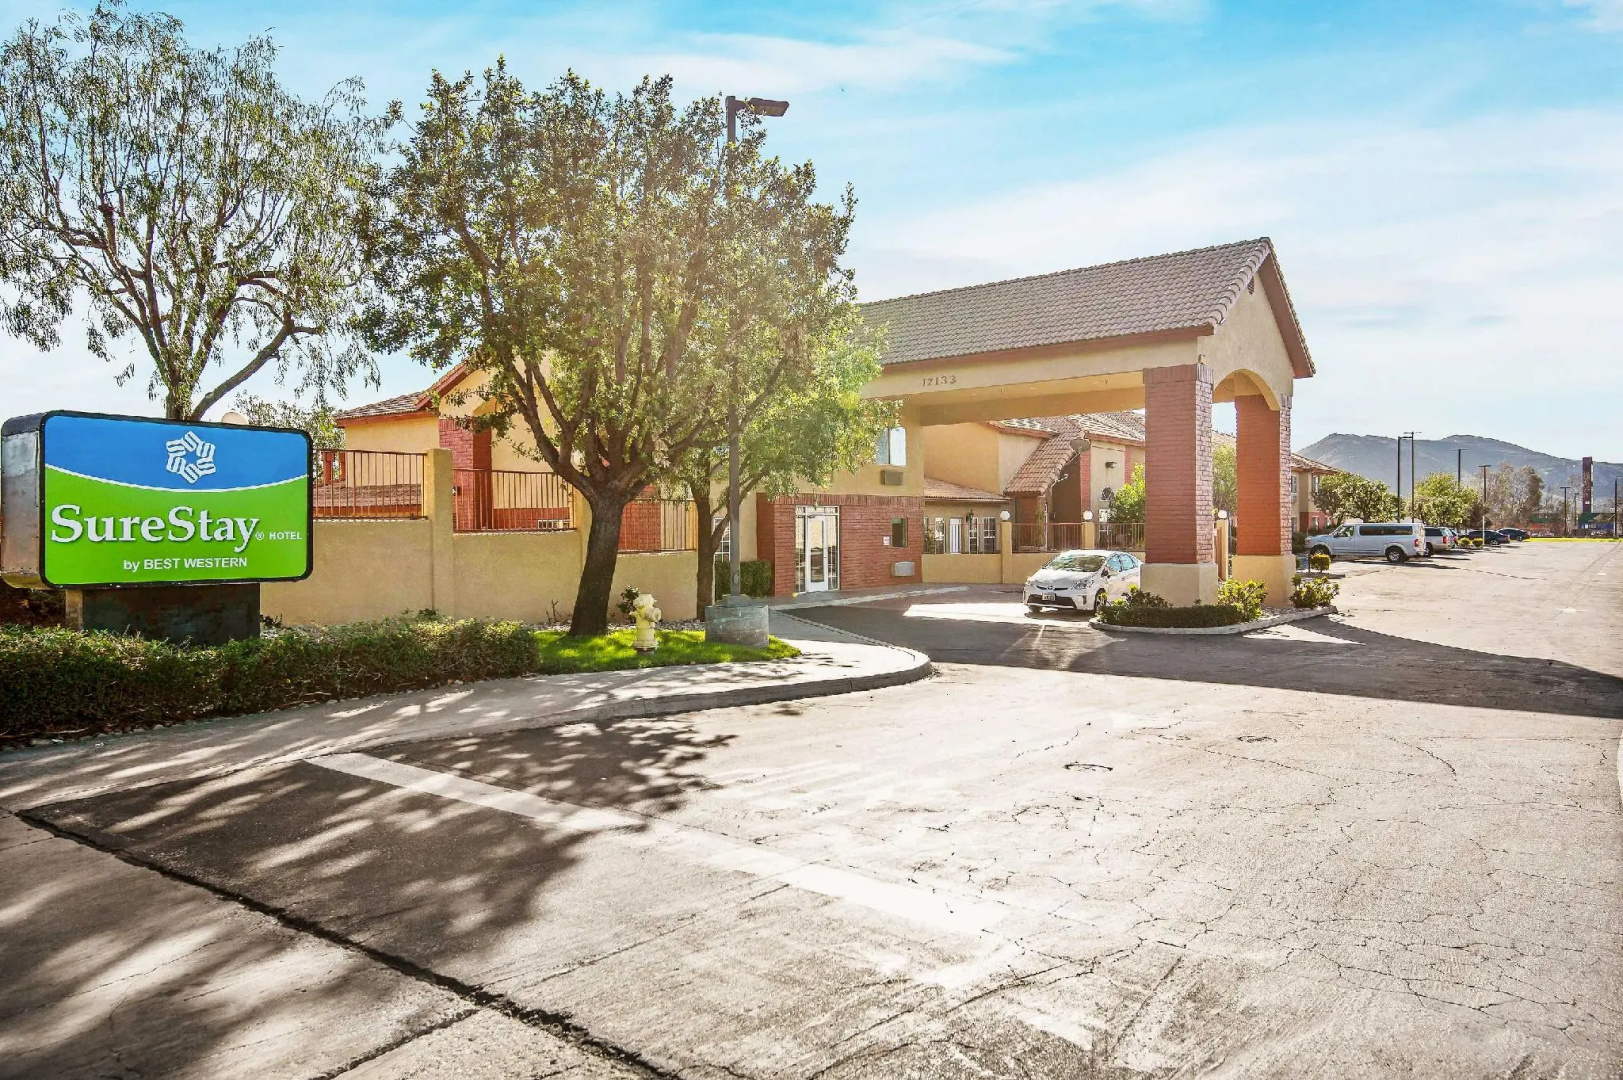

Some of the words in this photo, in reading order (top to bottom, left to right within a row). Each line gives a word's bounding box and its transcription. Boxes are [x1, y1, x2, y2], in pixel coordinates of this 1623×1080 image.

[922, 375, 956, 386] 17133
[269, 531, 303, 540] HOTEL
[123, 560, 140, 572] by
[143, 558, 180, 570] BEST
[184, 557, 248, 569] WESTERN
